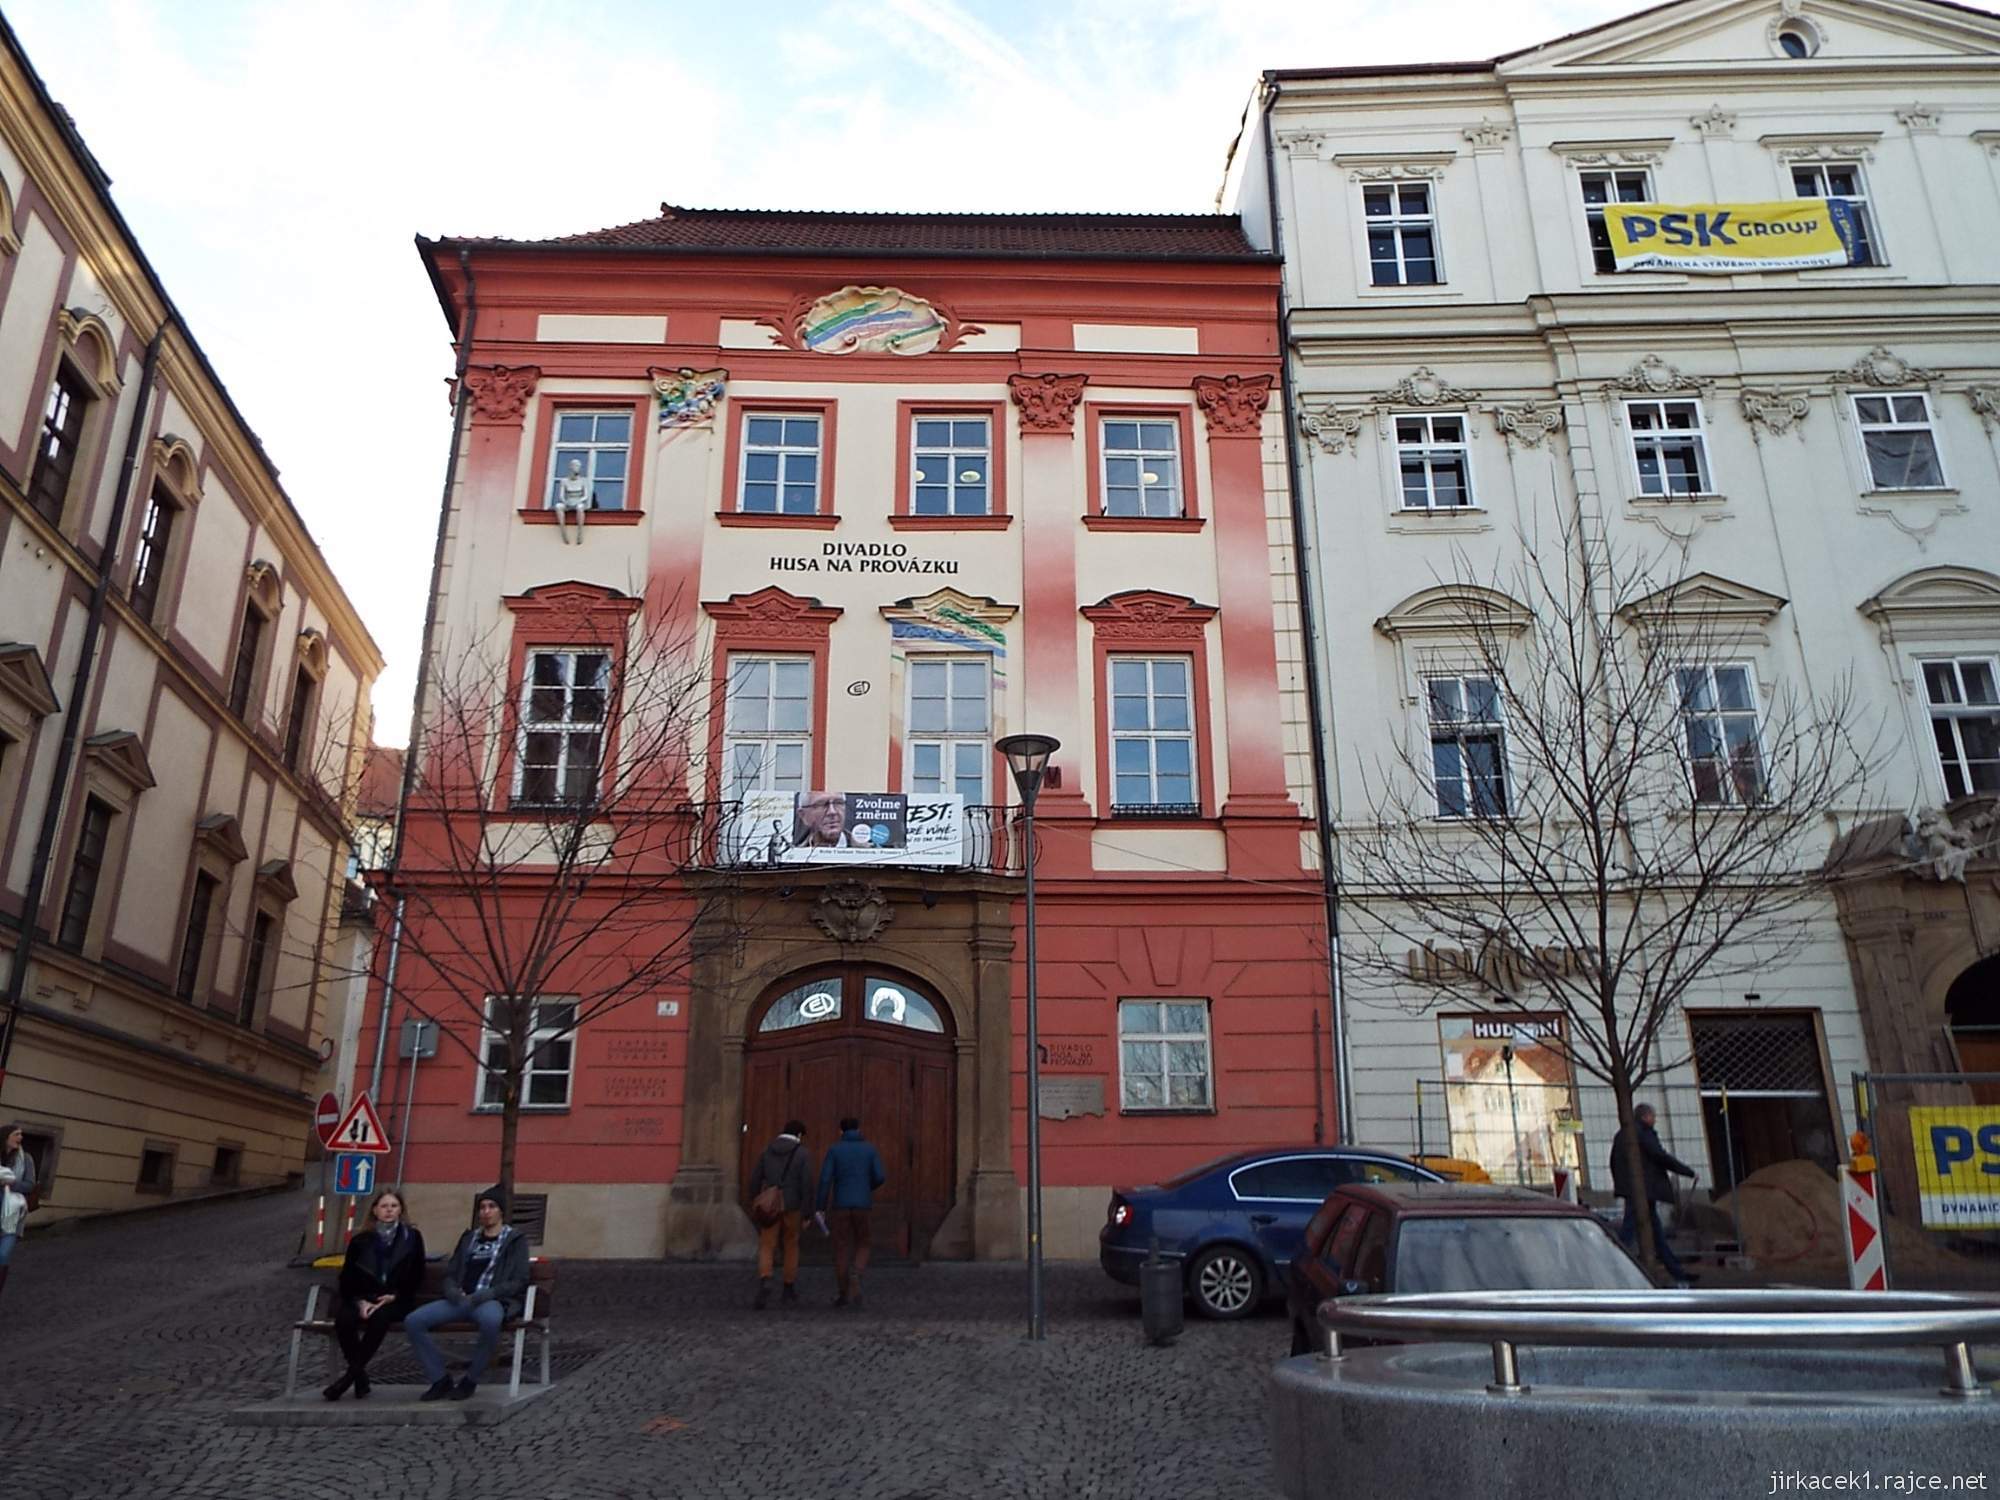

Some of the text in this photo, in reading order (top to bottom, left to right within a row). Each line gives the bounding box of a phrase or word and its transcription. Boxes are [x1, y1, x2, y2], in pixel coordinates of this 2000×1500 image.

[1622, 211, 1737, 247] PSK
[1737, 220, 1818, 237] GROUP
[823, 543, 907, 556] DIVADLO
[769, 557, 959, 574] HUSA NA PROVÁZKU
[855, 798, 901, 809] Zvolme
[855, 809, 897, 820] změnu
